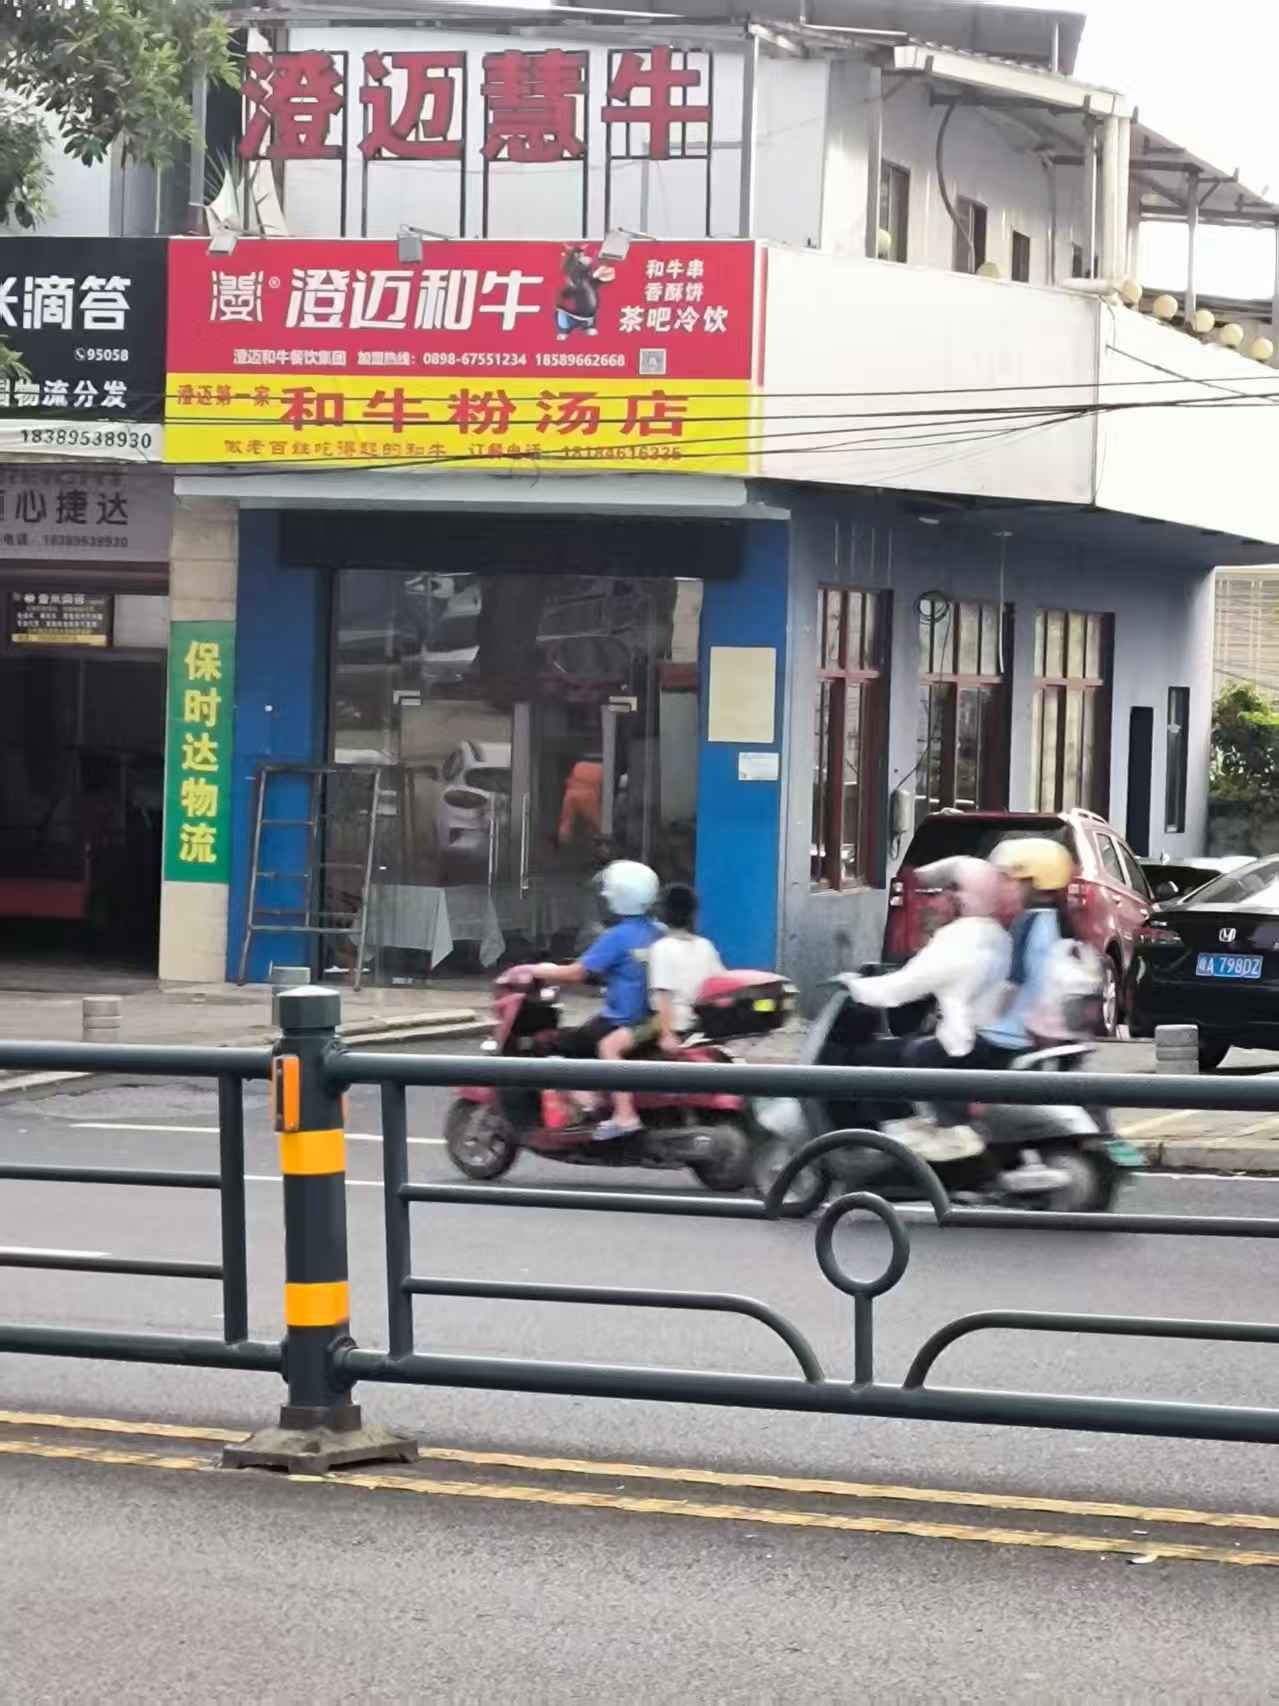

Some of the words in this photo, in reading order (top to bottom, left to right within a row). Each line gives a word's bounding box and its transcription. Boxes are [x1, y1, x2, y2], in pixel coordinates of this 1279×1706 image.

[239, 46, 712, 162] 澄迈慧牛
[645, 258, 704, 280] 和牛串
[285, 267, 544, 331] 澄迈和牛
[644, 282, 704, 303] 香酥饼
[619, 305, 729, 333] 茶吧冷饮
[87, 348, 129, 362] 95058
[423, 352, 527, 367] 0898-67551234
[535, 353, 626, 368] 18589662668
[177, 384, 271, 407] 澄迈第一家
[280, 386, 689, 437] 和牛粉汤店
[21, 429, 152, 449] 18389538930
[0, 488, 128, 526] 心捷达
[179, 640, 222, 864] 保时达物流
